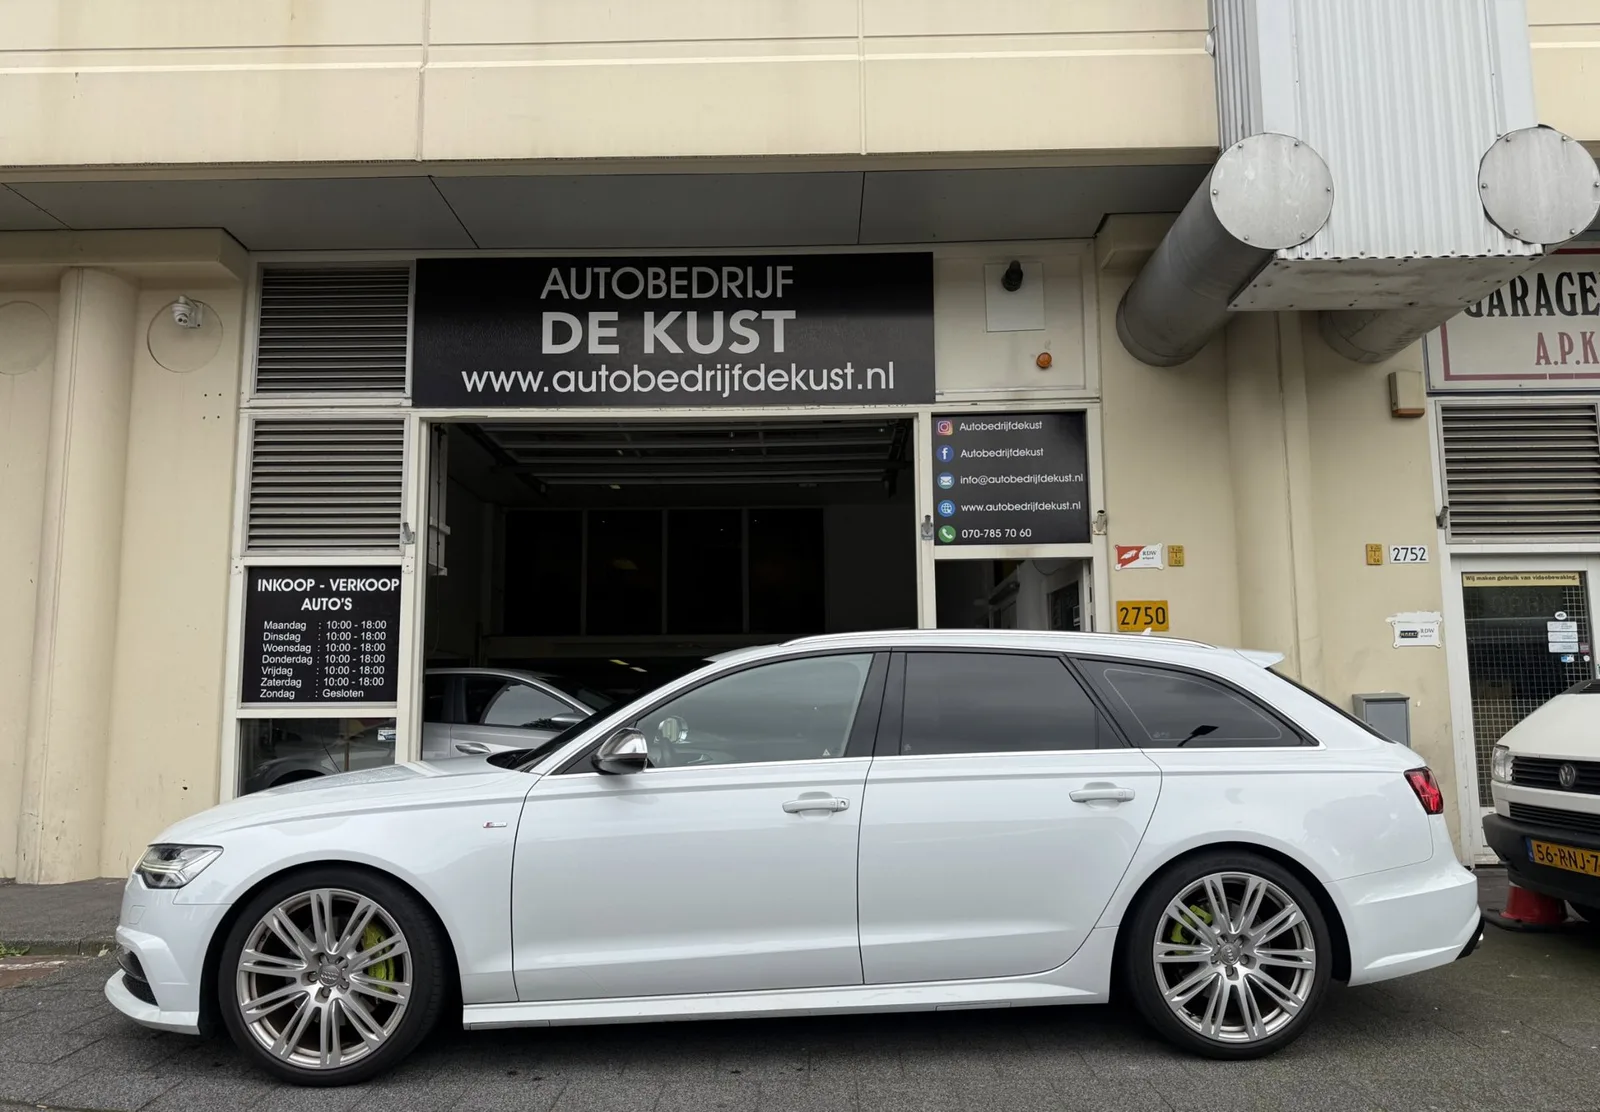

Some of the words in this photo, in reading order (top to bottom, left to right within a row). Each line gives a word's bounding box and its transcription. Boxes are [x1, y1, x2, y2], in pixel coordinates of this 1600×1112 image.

[540, 265, 794, 300] AUTOBEDRIJF
[541, 311, 620, 355] DE
[643, 309, 797, 355] KUST
[461, 361, 894, 398] www.autobedrijfdekust.nl
[959, 421, 1043, 432] Autobedrijfdekust
[960, 448, 1044, 459] Autobedrijfdekust
[960, 473, 1084, 486] info@autobedrijfdekust.nl
[960, 501, 1082, 512] www.autobedrijfdekust.nl
[961, 529, 1002, 539] 070-785
[1004, 529, 1017, 538] 70
[1019, 528, 1032, 538] 60
[1392, 547, 1427, 562] 2752
[257, 578, 316, 592] INKOOP
[329, 578, 400, 592] VERKOOP
[300, 597, 353, 611] AUTO'S
[1119, 606, 1166, 626] 2750
[263, 620, 307, 632] Maandag
[326, 620, 352, 630] 10:00
[361, 620, 387, 630] 18:00
[263, 632, 301, 643] Dinsdag
[325, 631, 351, 641] 10:00
[360, 631, 387, 641] 18:00
[262, 643, 312, 655] Woensdag
[325, 643, 351, 652] 10:00
[360, 643, 386, 652] 18:00
[262, 655, 313, 666] Donderdag
[324, 655, 350, 664] 10:00
[359, 654, 386, 664] 18:00
[261, 666, 293, 677] Vrijdag
[324, 666, 350, 675] 10:00
[359, 666, 385, 675] 18:00
[260, 677, 302, 689] Zaterdag
[323, 677, 349, 687] 10:00
[358, 677, 385, 687] 18:00
[259, 689, 296, 700] Zondag
[322, 689, 364, 698] Gesloten
[1536, 844, 1599, 873] 56-RNJ-7
